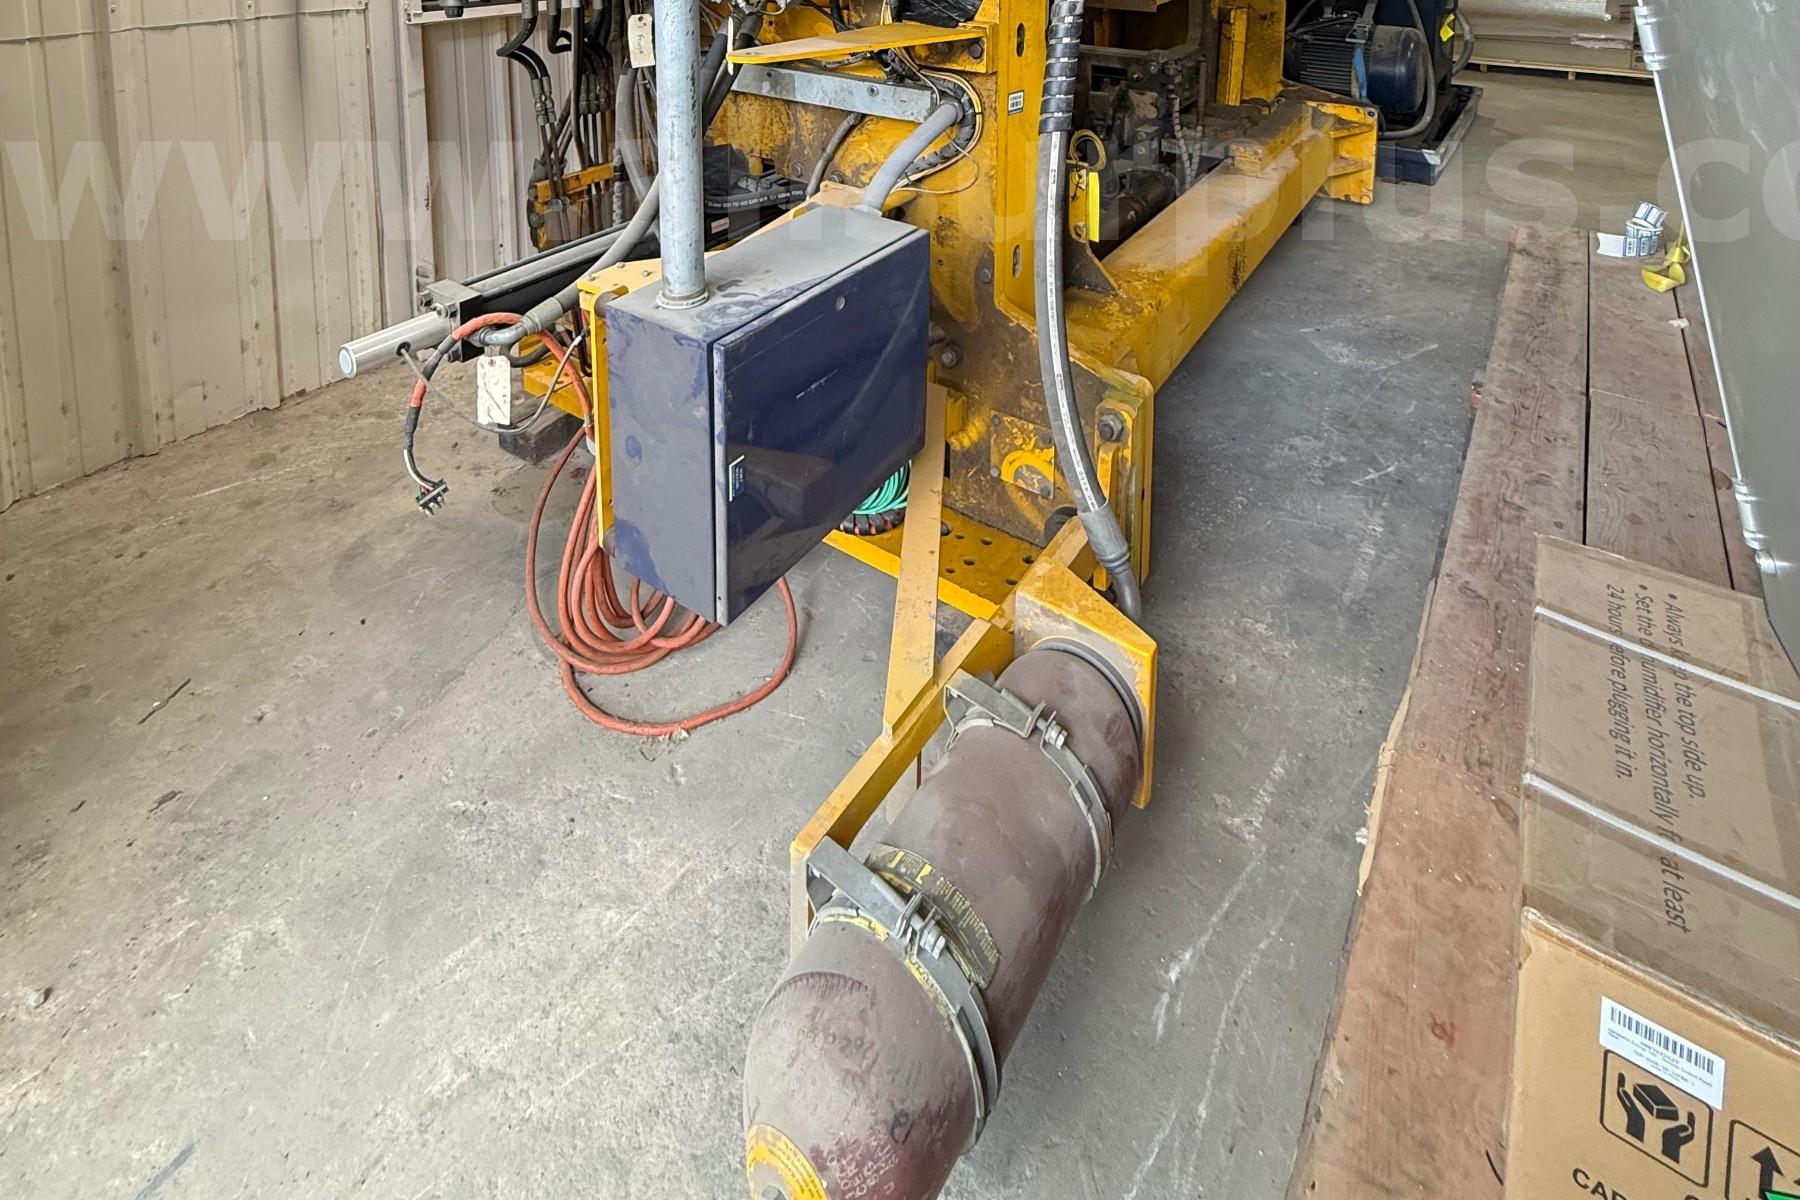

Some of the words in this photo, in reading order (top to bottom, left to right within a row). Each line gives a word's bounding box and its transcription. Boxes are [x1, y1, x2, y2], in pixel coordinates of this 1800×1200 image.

[1606, 583, 1625, 601] 24
[1634, 593, 1655, 614] Set
[1607, 601, 1627, 635] hours
[1637, 615, 1657, 636] the
[1662, 601, 1686, 647] Always
[1608, 642, 1631, 680] efore
[1674, 682, 1698, 707] the
[1606, 678, 1636, 744] plugging
[1674, 709, 1699, 736] top
[1614, 744, 1637, 760] it
[1680, 737, 1708, 772] side
[1615, 760, 1638, 779] in.
[1646, 725, 1680, 826] horizontally
[1681, 773, 1707, 799] up.
[1659, 856, 1685, 880] at
[1662, 880, 1692, 934] least
